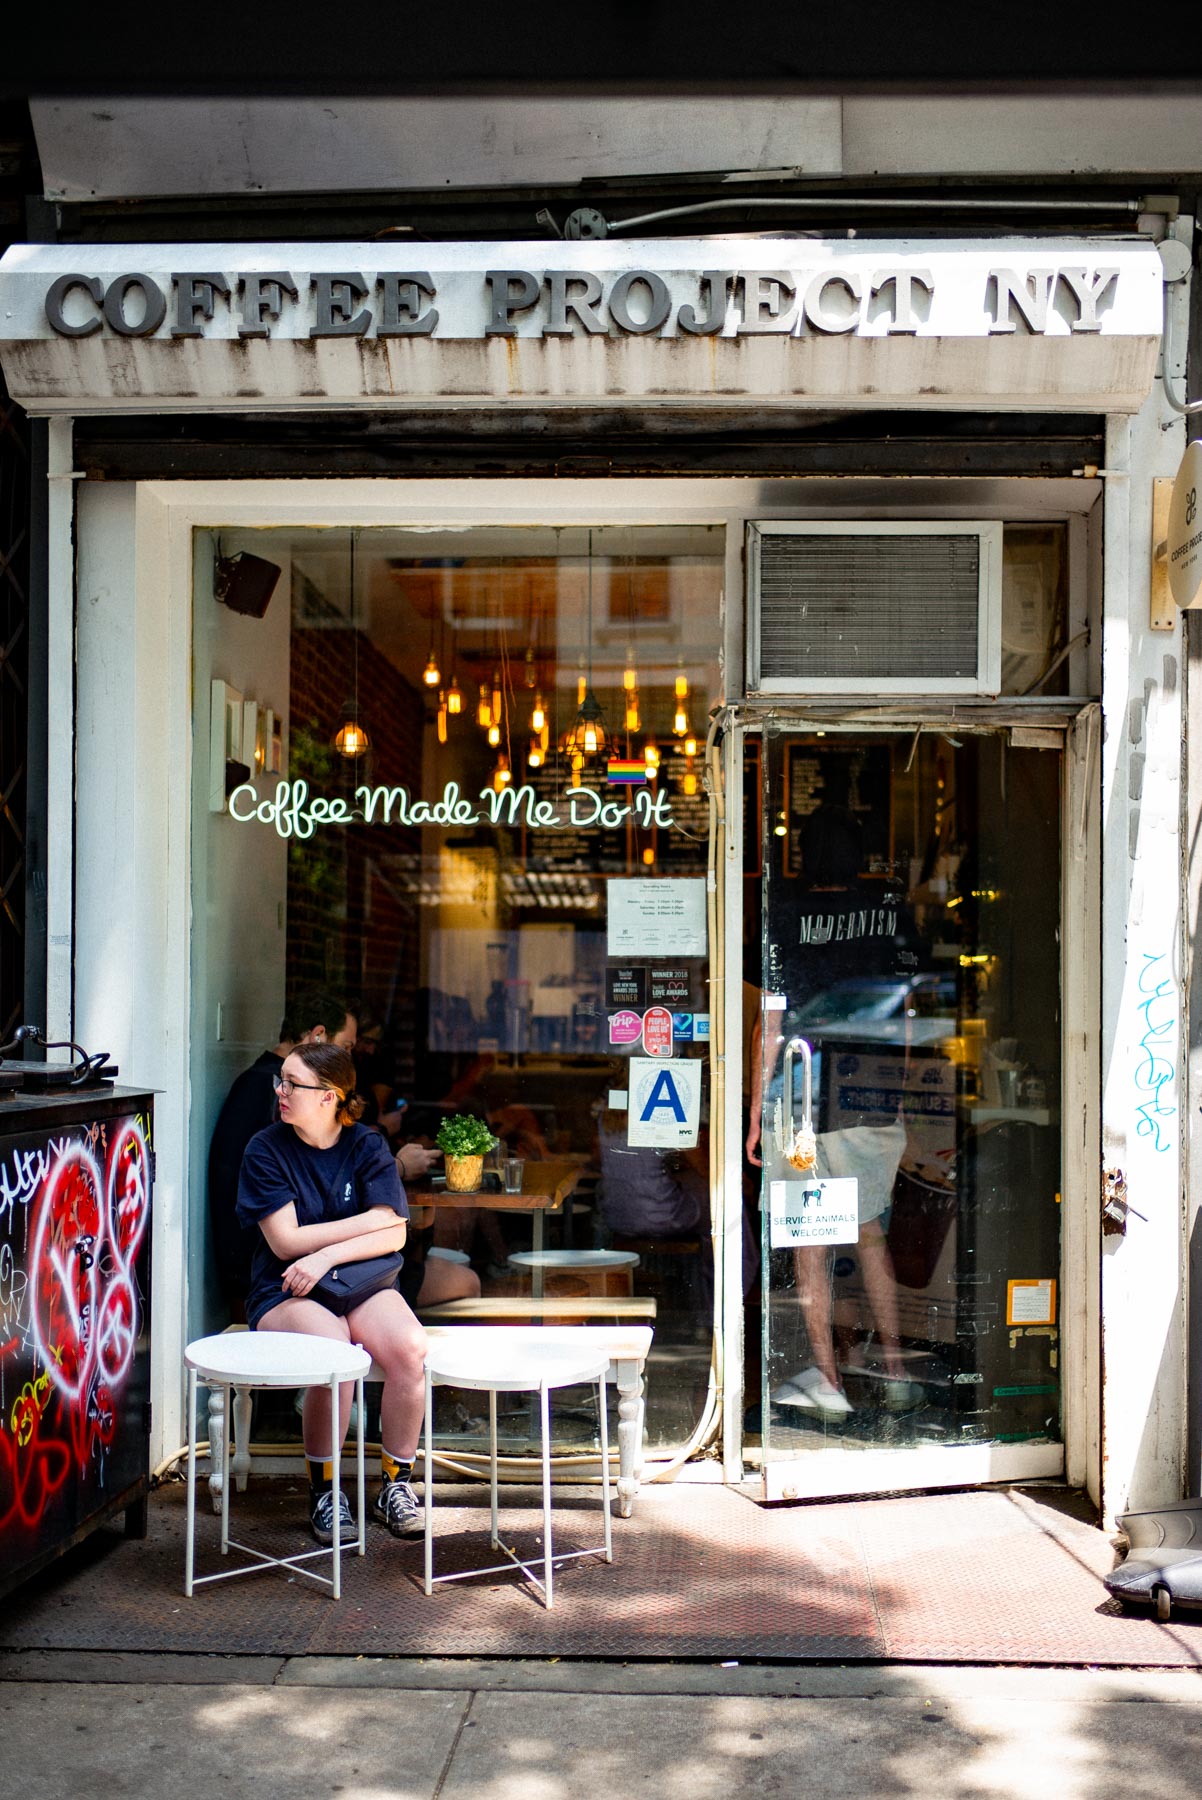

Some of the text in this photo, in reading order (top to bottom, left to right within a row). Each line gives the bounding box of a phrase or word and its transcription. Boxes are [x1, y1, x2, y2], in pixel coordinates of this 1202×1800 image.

[44, 265, 1120, 339] COFFEE PROJECT NY
[1171, 541, 1189, 562] COFFEE
[228, 779, 352, 839] Coffee
[355, 781, 480, 826] Made
[480, 784, 561, 828] Me
[565, 786, 632, 828] Do
[635, 787, 674, 828] It
[613, 994, 638, 1003] WINNER
[648, 1017, 667, 1025] PEOPLE
[648, 1025, 660, 1033] LOVE
[640, 1070, 687, 1122] A
[773, 1214, 856, 1226] SERVICE ANIMALS
[791, 1228, 838, 1238] WELCOME
